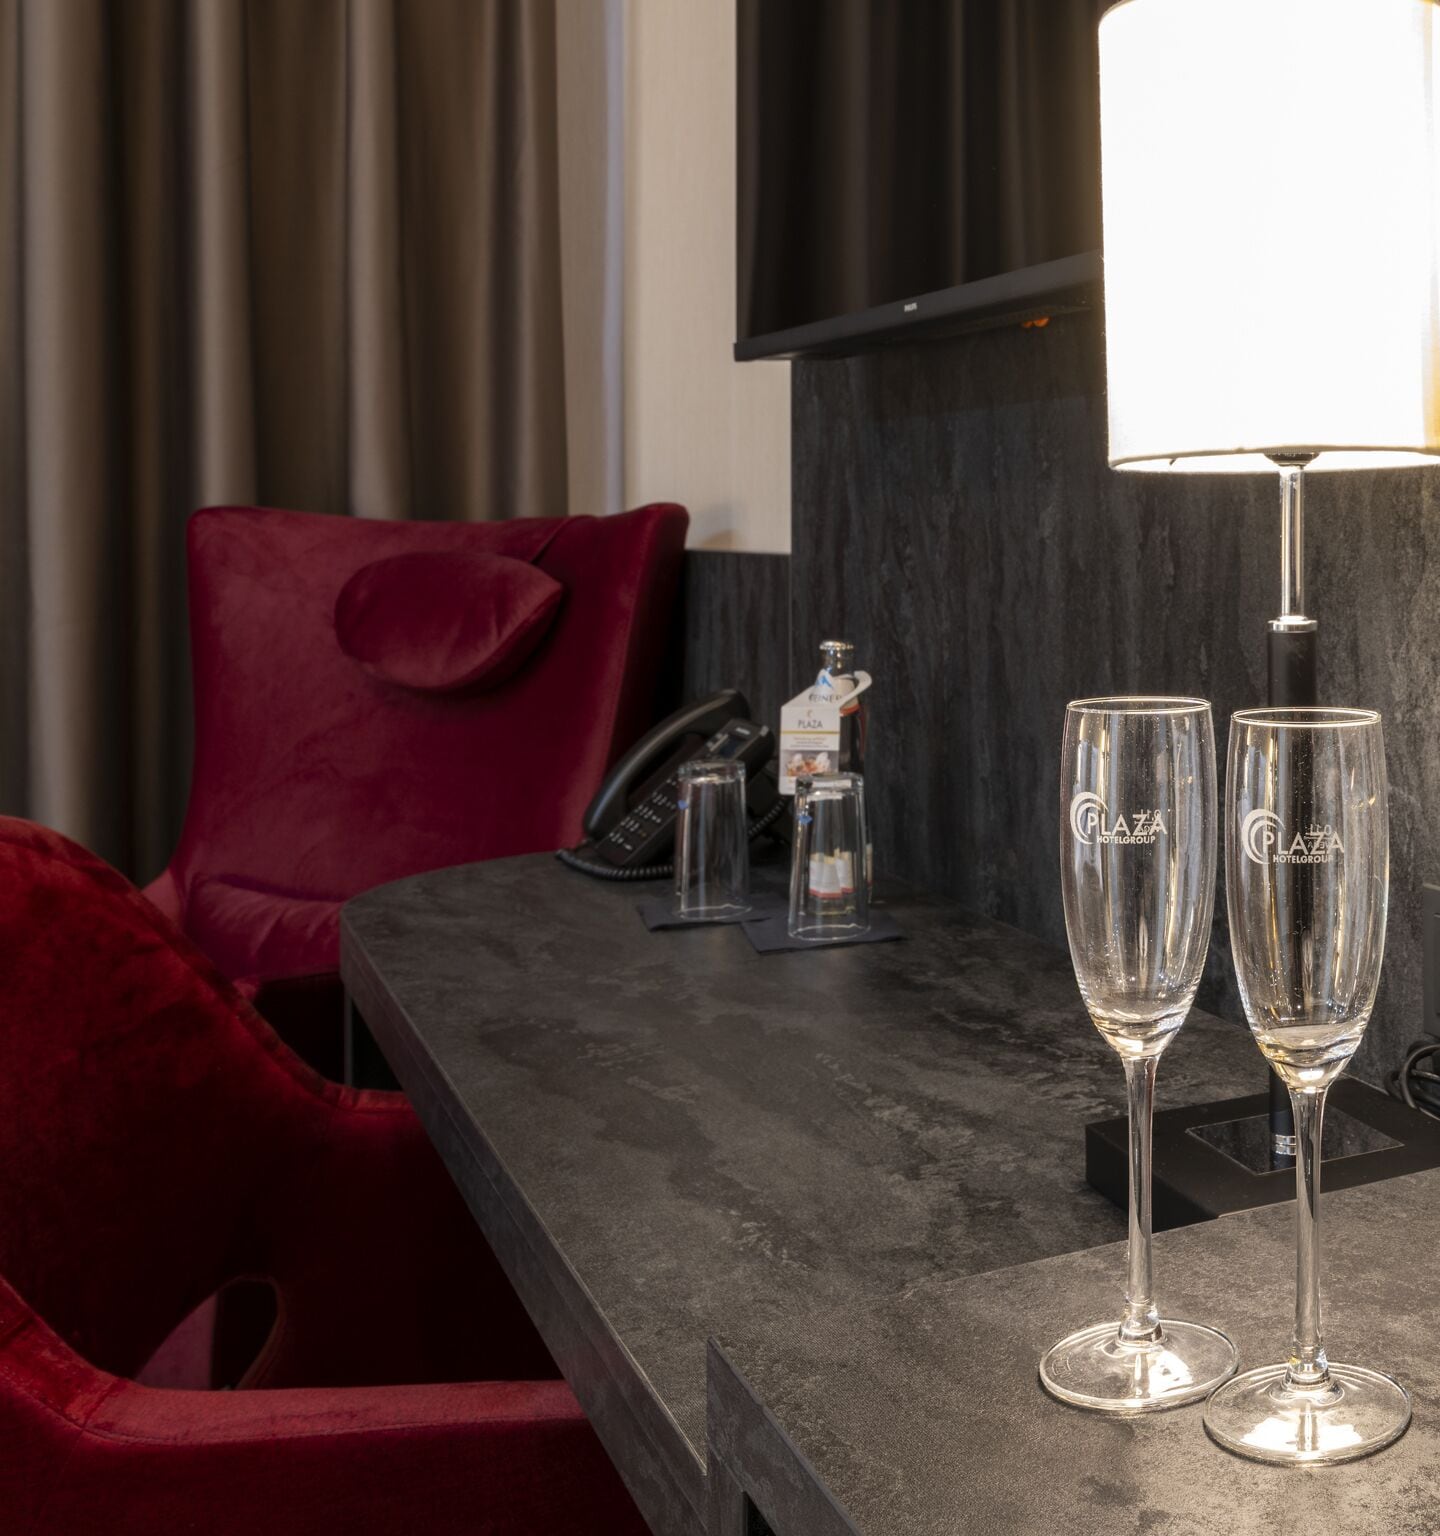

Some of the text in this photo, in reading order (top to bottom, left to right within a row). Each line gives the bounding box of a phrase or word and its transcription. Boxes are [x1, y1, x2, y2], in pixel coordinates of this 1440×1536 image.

[798, 720, 823, 729] PLAZA
[1088, 812, 1168, 836] PLAZA
[1096, 835, 1156, 845] HOTELGROUP
[1262, 831, 1344, 855] PLAZA
[1272, 854, 1334, 864] HOTELGROUP
